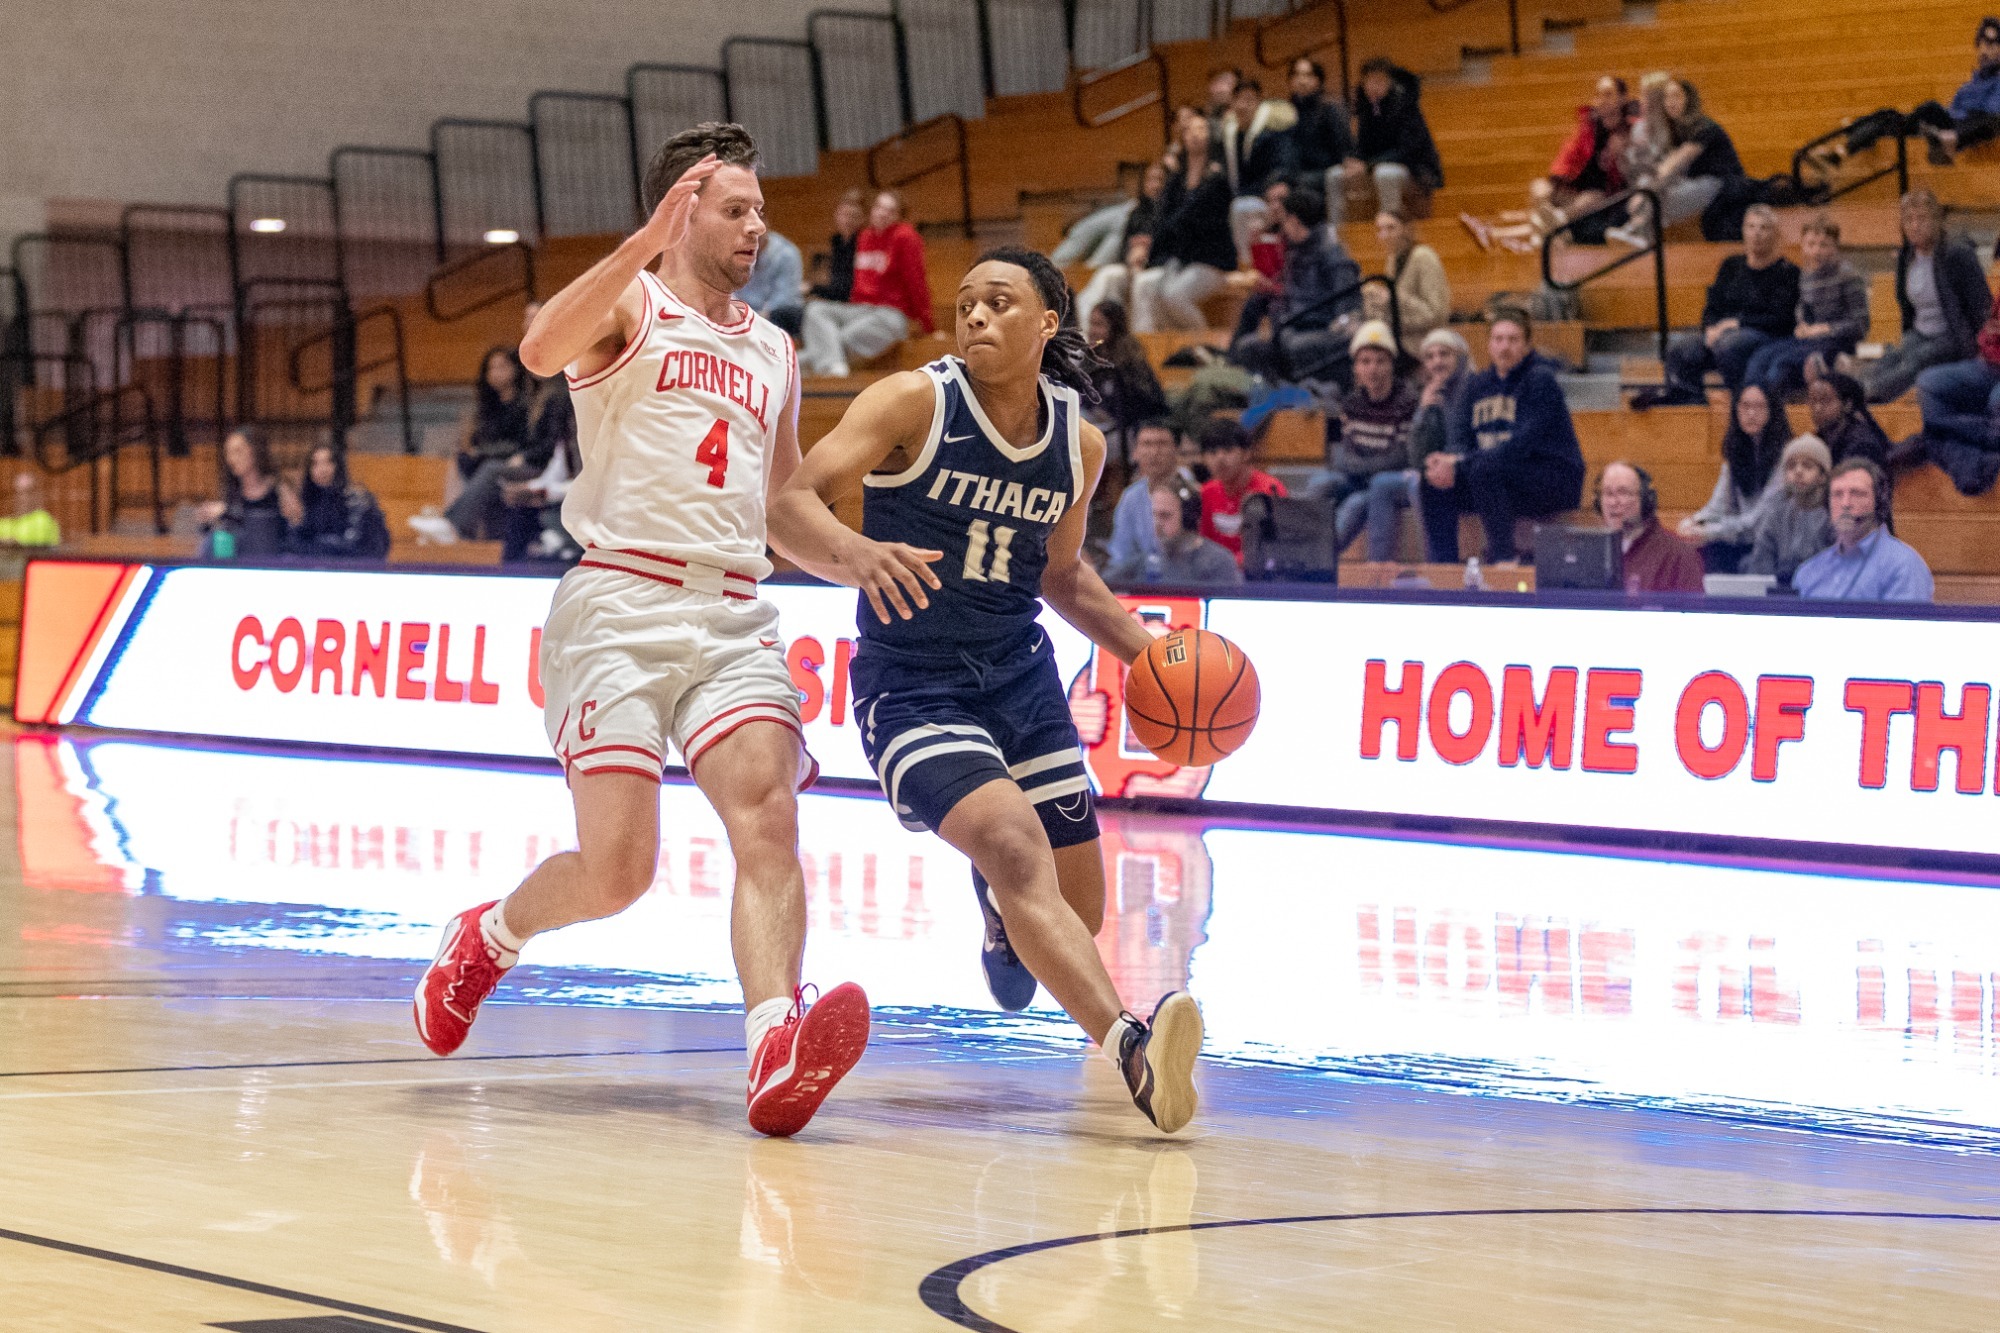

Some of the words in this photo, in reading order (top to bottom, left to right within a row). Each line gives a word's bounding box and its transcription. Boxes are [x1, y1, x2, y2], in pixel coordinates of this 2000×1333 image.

[656, 350, 770, 435] CORNELL
[695, 418, 730, 489] 4
[926, 468, 1068, 525] ITHACA
[962, 518, 1018, 583] 11
[231, 615, 501, 705] CORNELL
[578, 700, 597, 742] C
[1358, 658, 1644, 775] HOME
[1674, 669, 1815, 783] OF
[1843, 677, 2000, 796] TH
